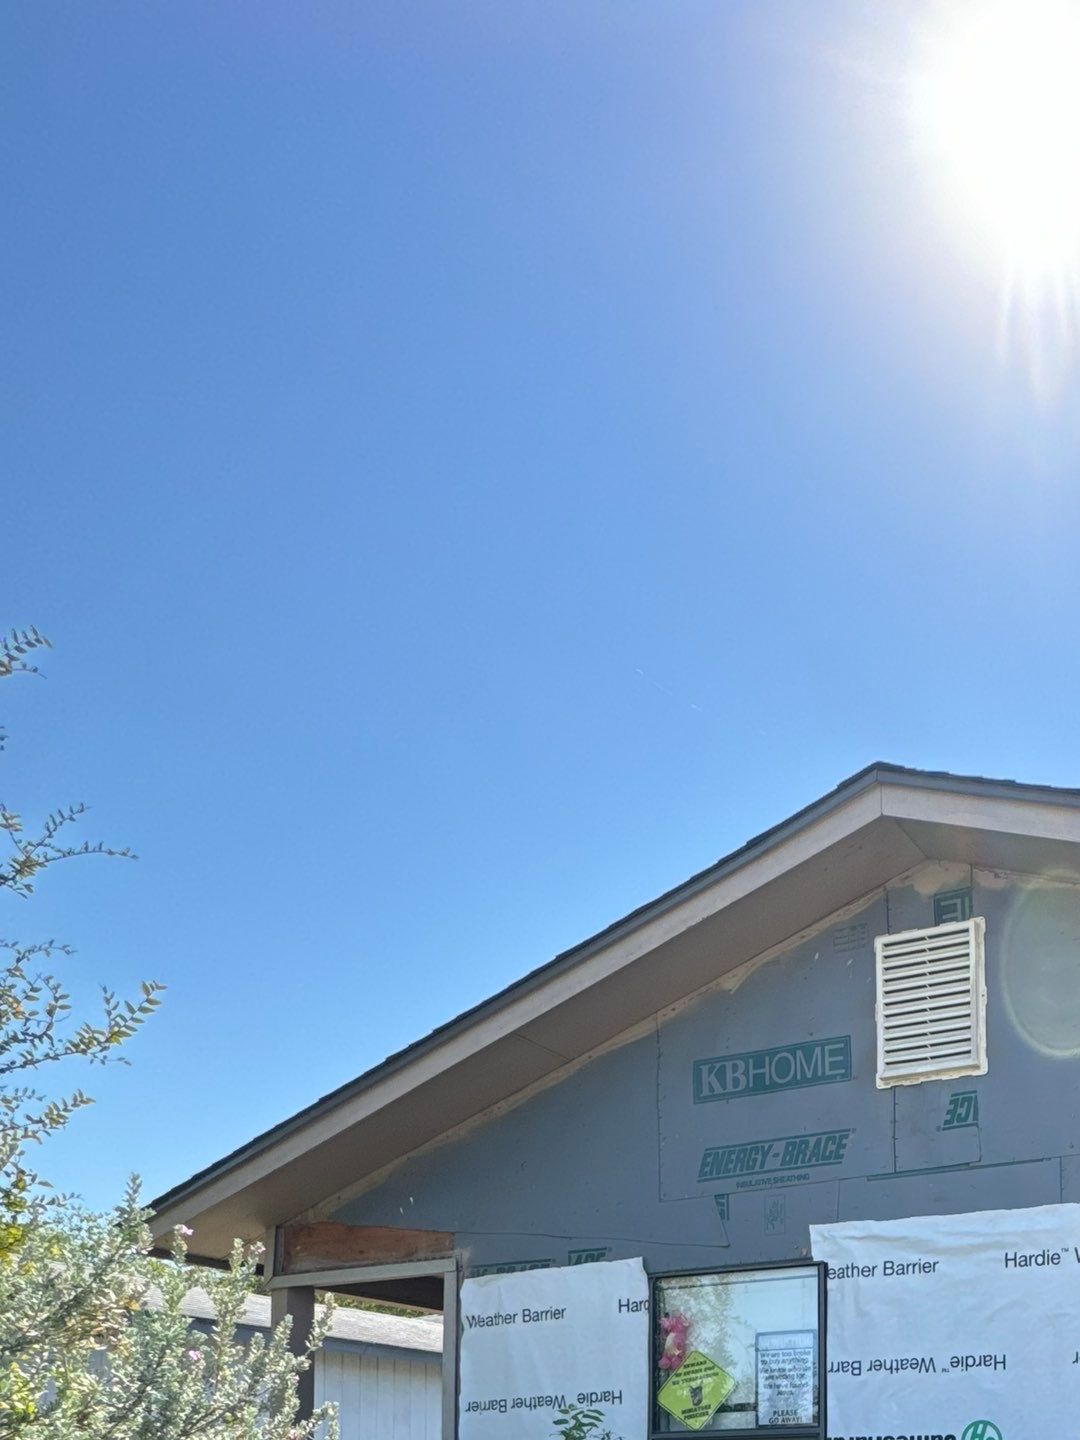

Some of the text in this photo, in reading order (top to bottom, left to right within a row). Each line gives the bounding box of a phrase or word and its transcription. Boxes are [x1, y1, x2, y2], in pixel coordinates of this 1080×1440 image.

[883, 1258, 940, 1277] Barrier
[466, 1306, 567, 1328] Weather Barrier
[867, 1357, 936, 1375] Weather
[464, 1398, 507, 1415] Barrier
[510, 1394, 567, 1412] Weather
[772, 1409, 798, 1417] PLEASE
